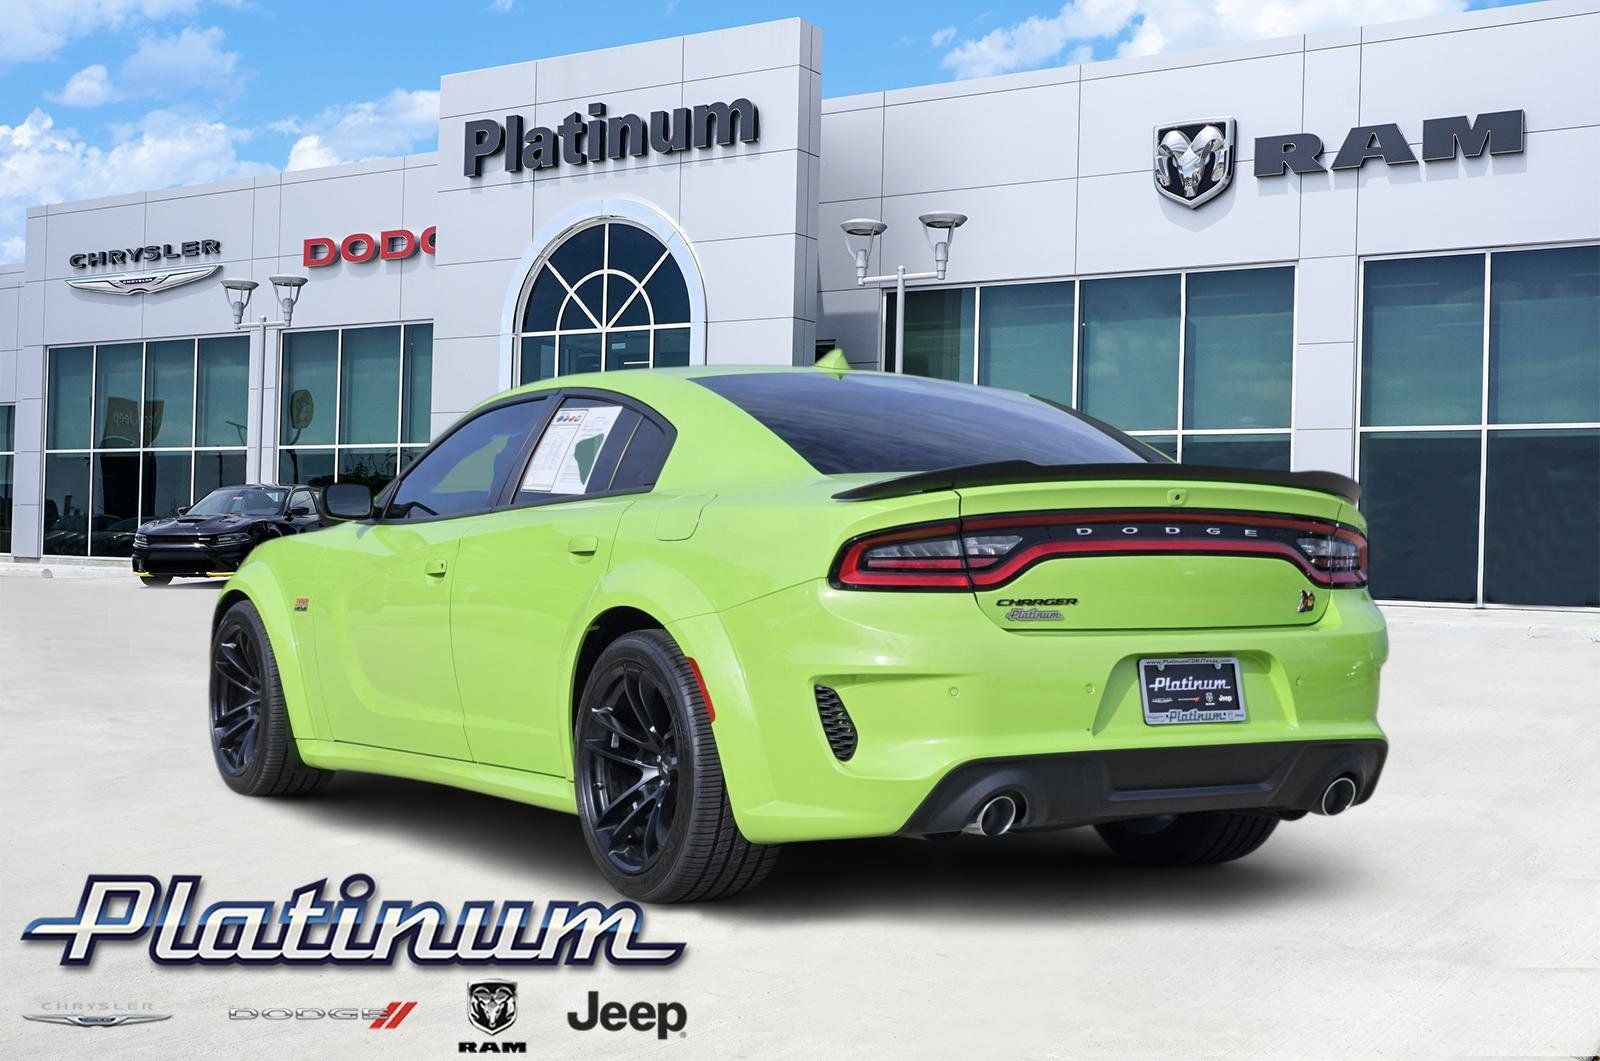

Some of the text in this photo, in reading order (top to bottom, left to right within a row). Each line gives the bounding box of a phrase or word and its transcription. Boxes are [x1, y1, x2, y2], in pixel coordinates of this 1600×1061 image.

[464, 98, 760, 178] Platinum
[1254, 109, 1524, 178] RAM
[69, 239, 221, 269] CHRYSLER
[1075, 526, 1258, 537] DODGE
[996, 598, 1079, 607] CHARGER
[1005, 607, 1065, 621] Platinum
[1148, 676, 1231, 691] Platinum
[1168, 709, 1225, 722] Platinum
